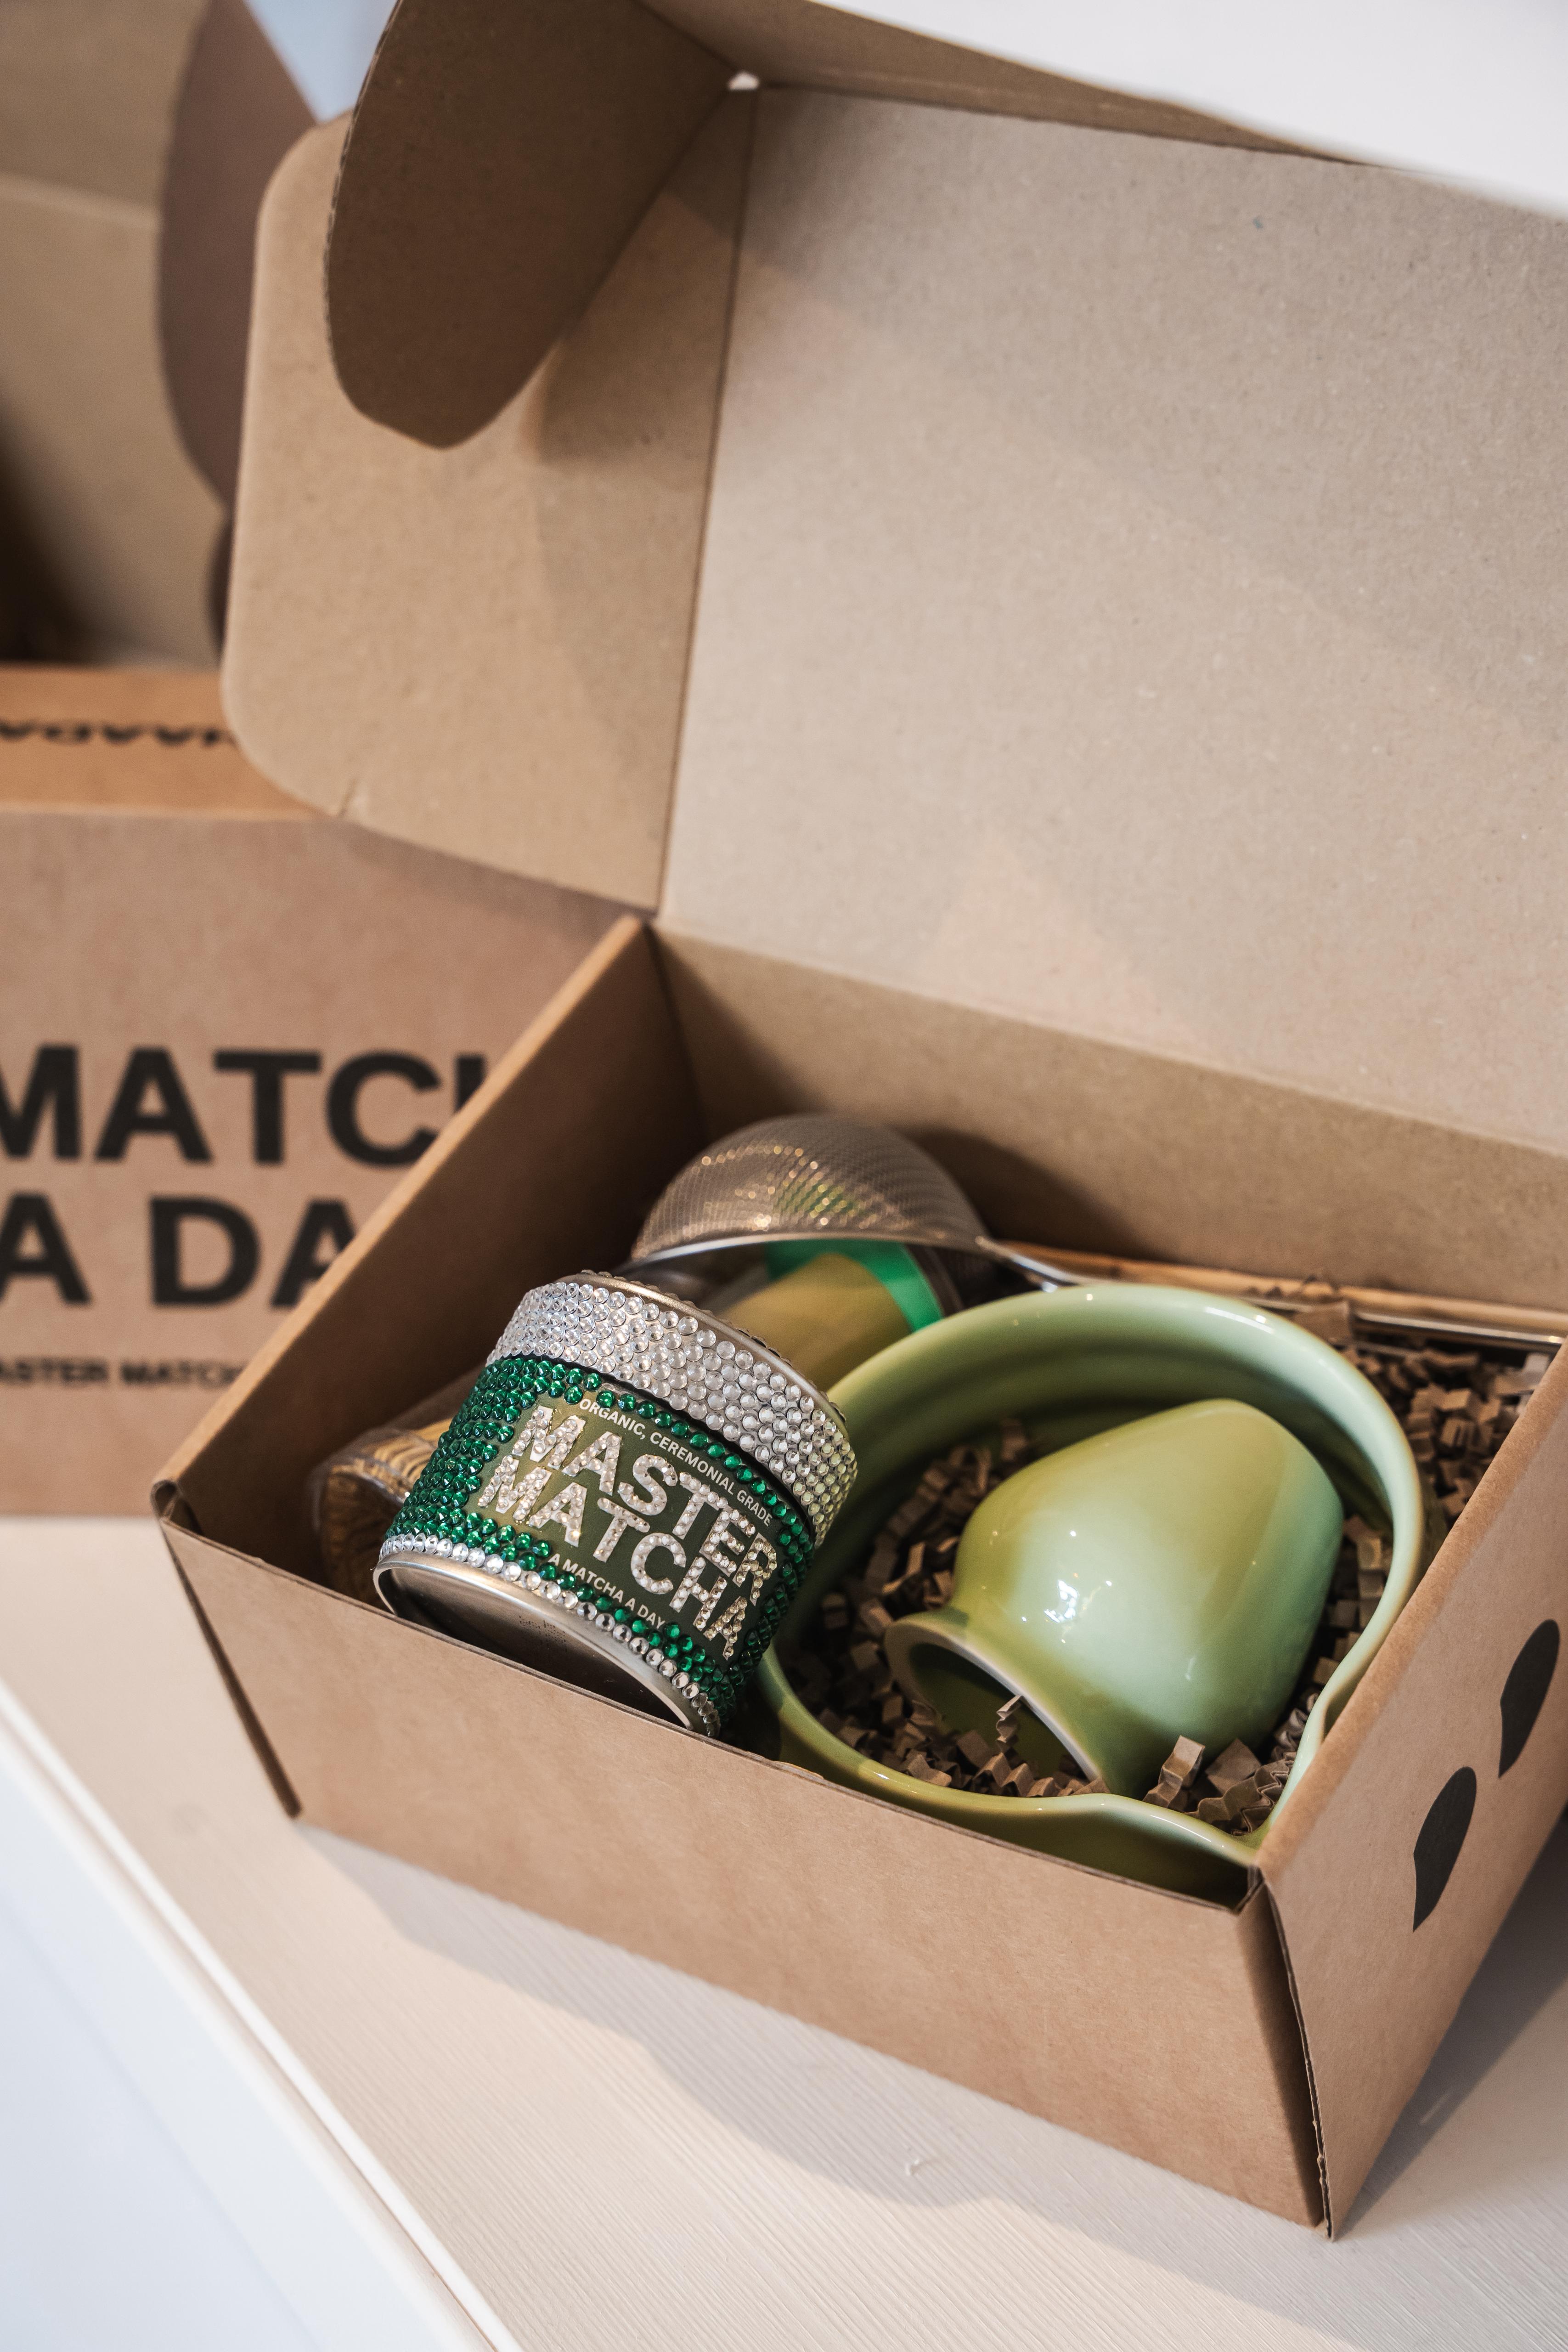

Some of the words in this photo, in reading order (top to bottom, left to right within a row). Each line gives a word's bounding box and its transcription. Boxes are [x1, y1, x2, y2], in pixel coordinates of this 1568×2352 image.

[0, 1192, 91, 1307] A
[511, 1405, 778, 1606] MASTER
[579, 1398, 646, 1441] ORGANIC,
[649, 1431, 734, 1496] CEREMONIAL
[736, 1489, 773, 1527] GRADE
[477, 1454, 748, 1661] MATCHA
[547, 1553, 561, 1566] A
[562, 1558, 624, 1603] MATCHA
[624, 1597, 636, 1611] A
[637, 1604, 666, 1630] DAY
